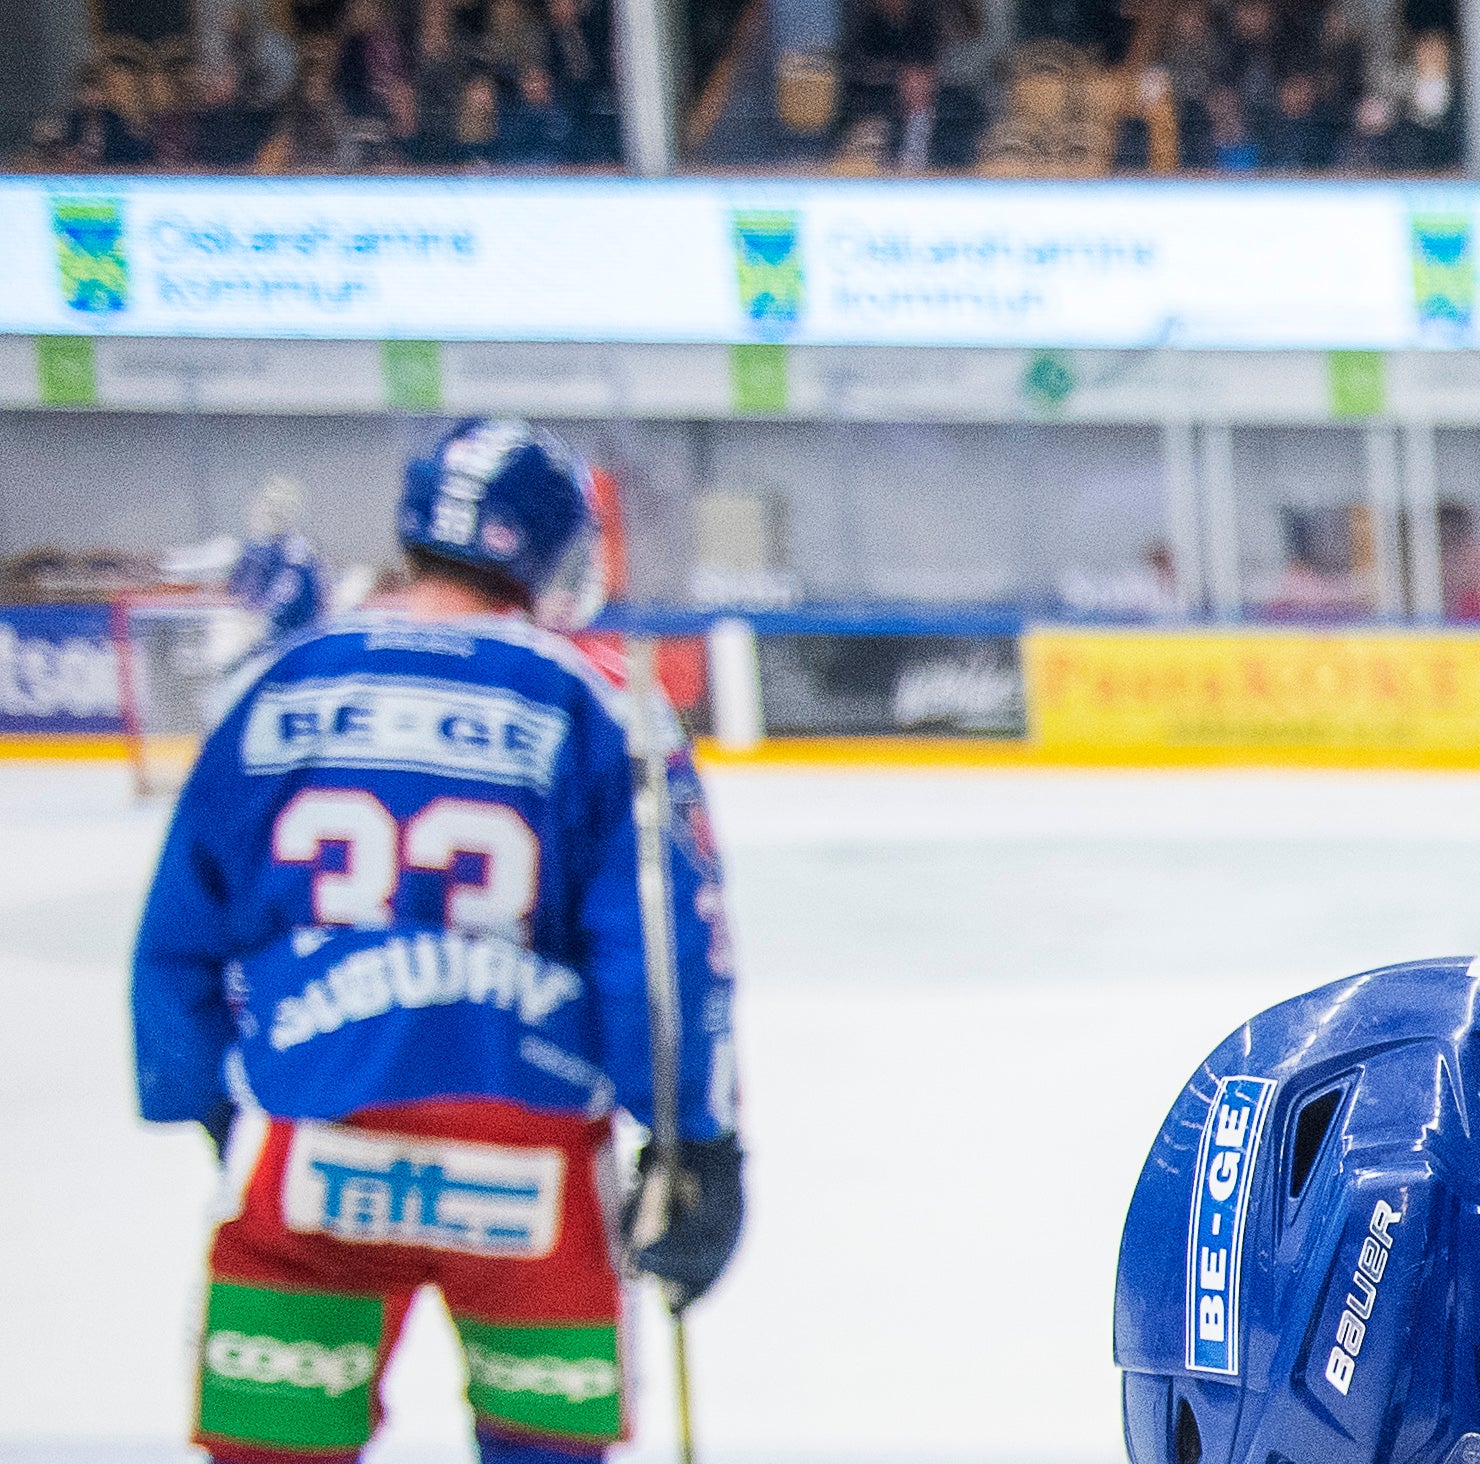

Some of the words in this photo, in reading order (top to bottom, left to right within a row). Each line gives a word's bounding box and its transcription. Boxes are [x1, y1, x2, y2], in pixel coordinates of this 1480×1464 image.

[280, 704, 546, 760] BE-GE
[1197, 1100, 1252, 1344] BE-GE
[206, 1328, 379, 1398] coop
[1325, 1199, 1402, 1396] BAUER
